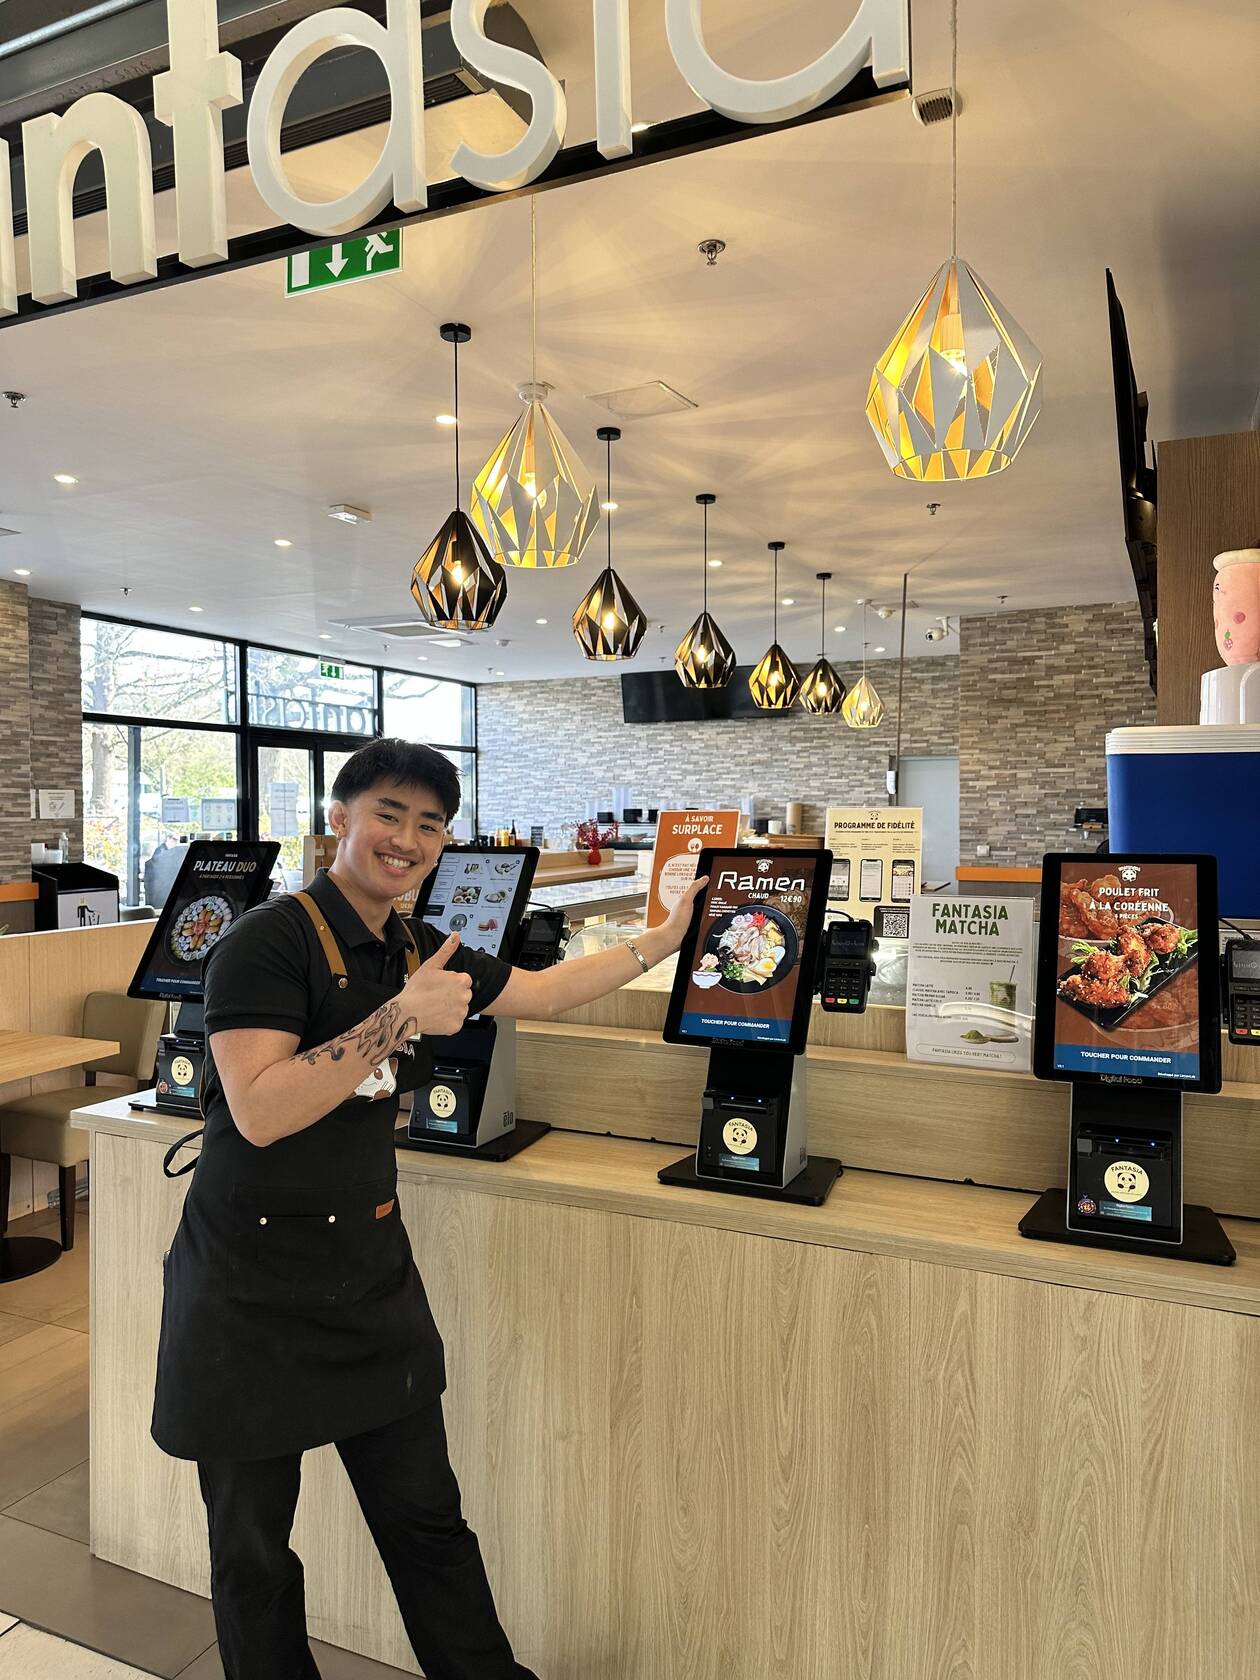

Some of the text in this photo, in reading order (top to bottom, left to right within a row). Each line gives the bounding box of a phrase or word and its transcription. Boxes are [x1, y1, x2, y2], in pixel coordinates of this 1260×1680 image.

[0, 0, 911, 314] ntasia
[685, 814, 690, 823] À
[887, 820, 916, 829] FIDÉLITÉ
[672, 824, 724, 835] SURPLACE
[193, 860, 257, 873] PLATEAU DUO
[717, 871, 805, 892] Ramen
[748, 892, 770, 900] CHAUD
[1099, 888, 1160, 897] POULET FRIT
[1089, 898, 1169, 912] À LA CORÉENNE
[932, 903, 1009, 920] FANTASIA
[935, 919, 1000, 936] MATCHA
[701, 1018, 724, 1026] TOUCHER
[738, 1021, 770, 1030] COMMANDER
[1080, 1051, 1172, 1064] TOUCHER POUR COMMANDER
[728, 1121, 754, 1132] FANTASIA
[1110, 1165, 1144, 1175] FANTASIA
